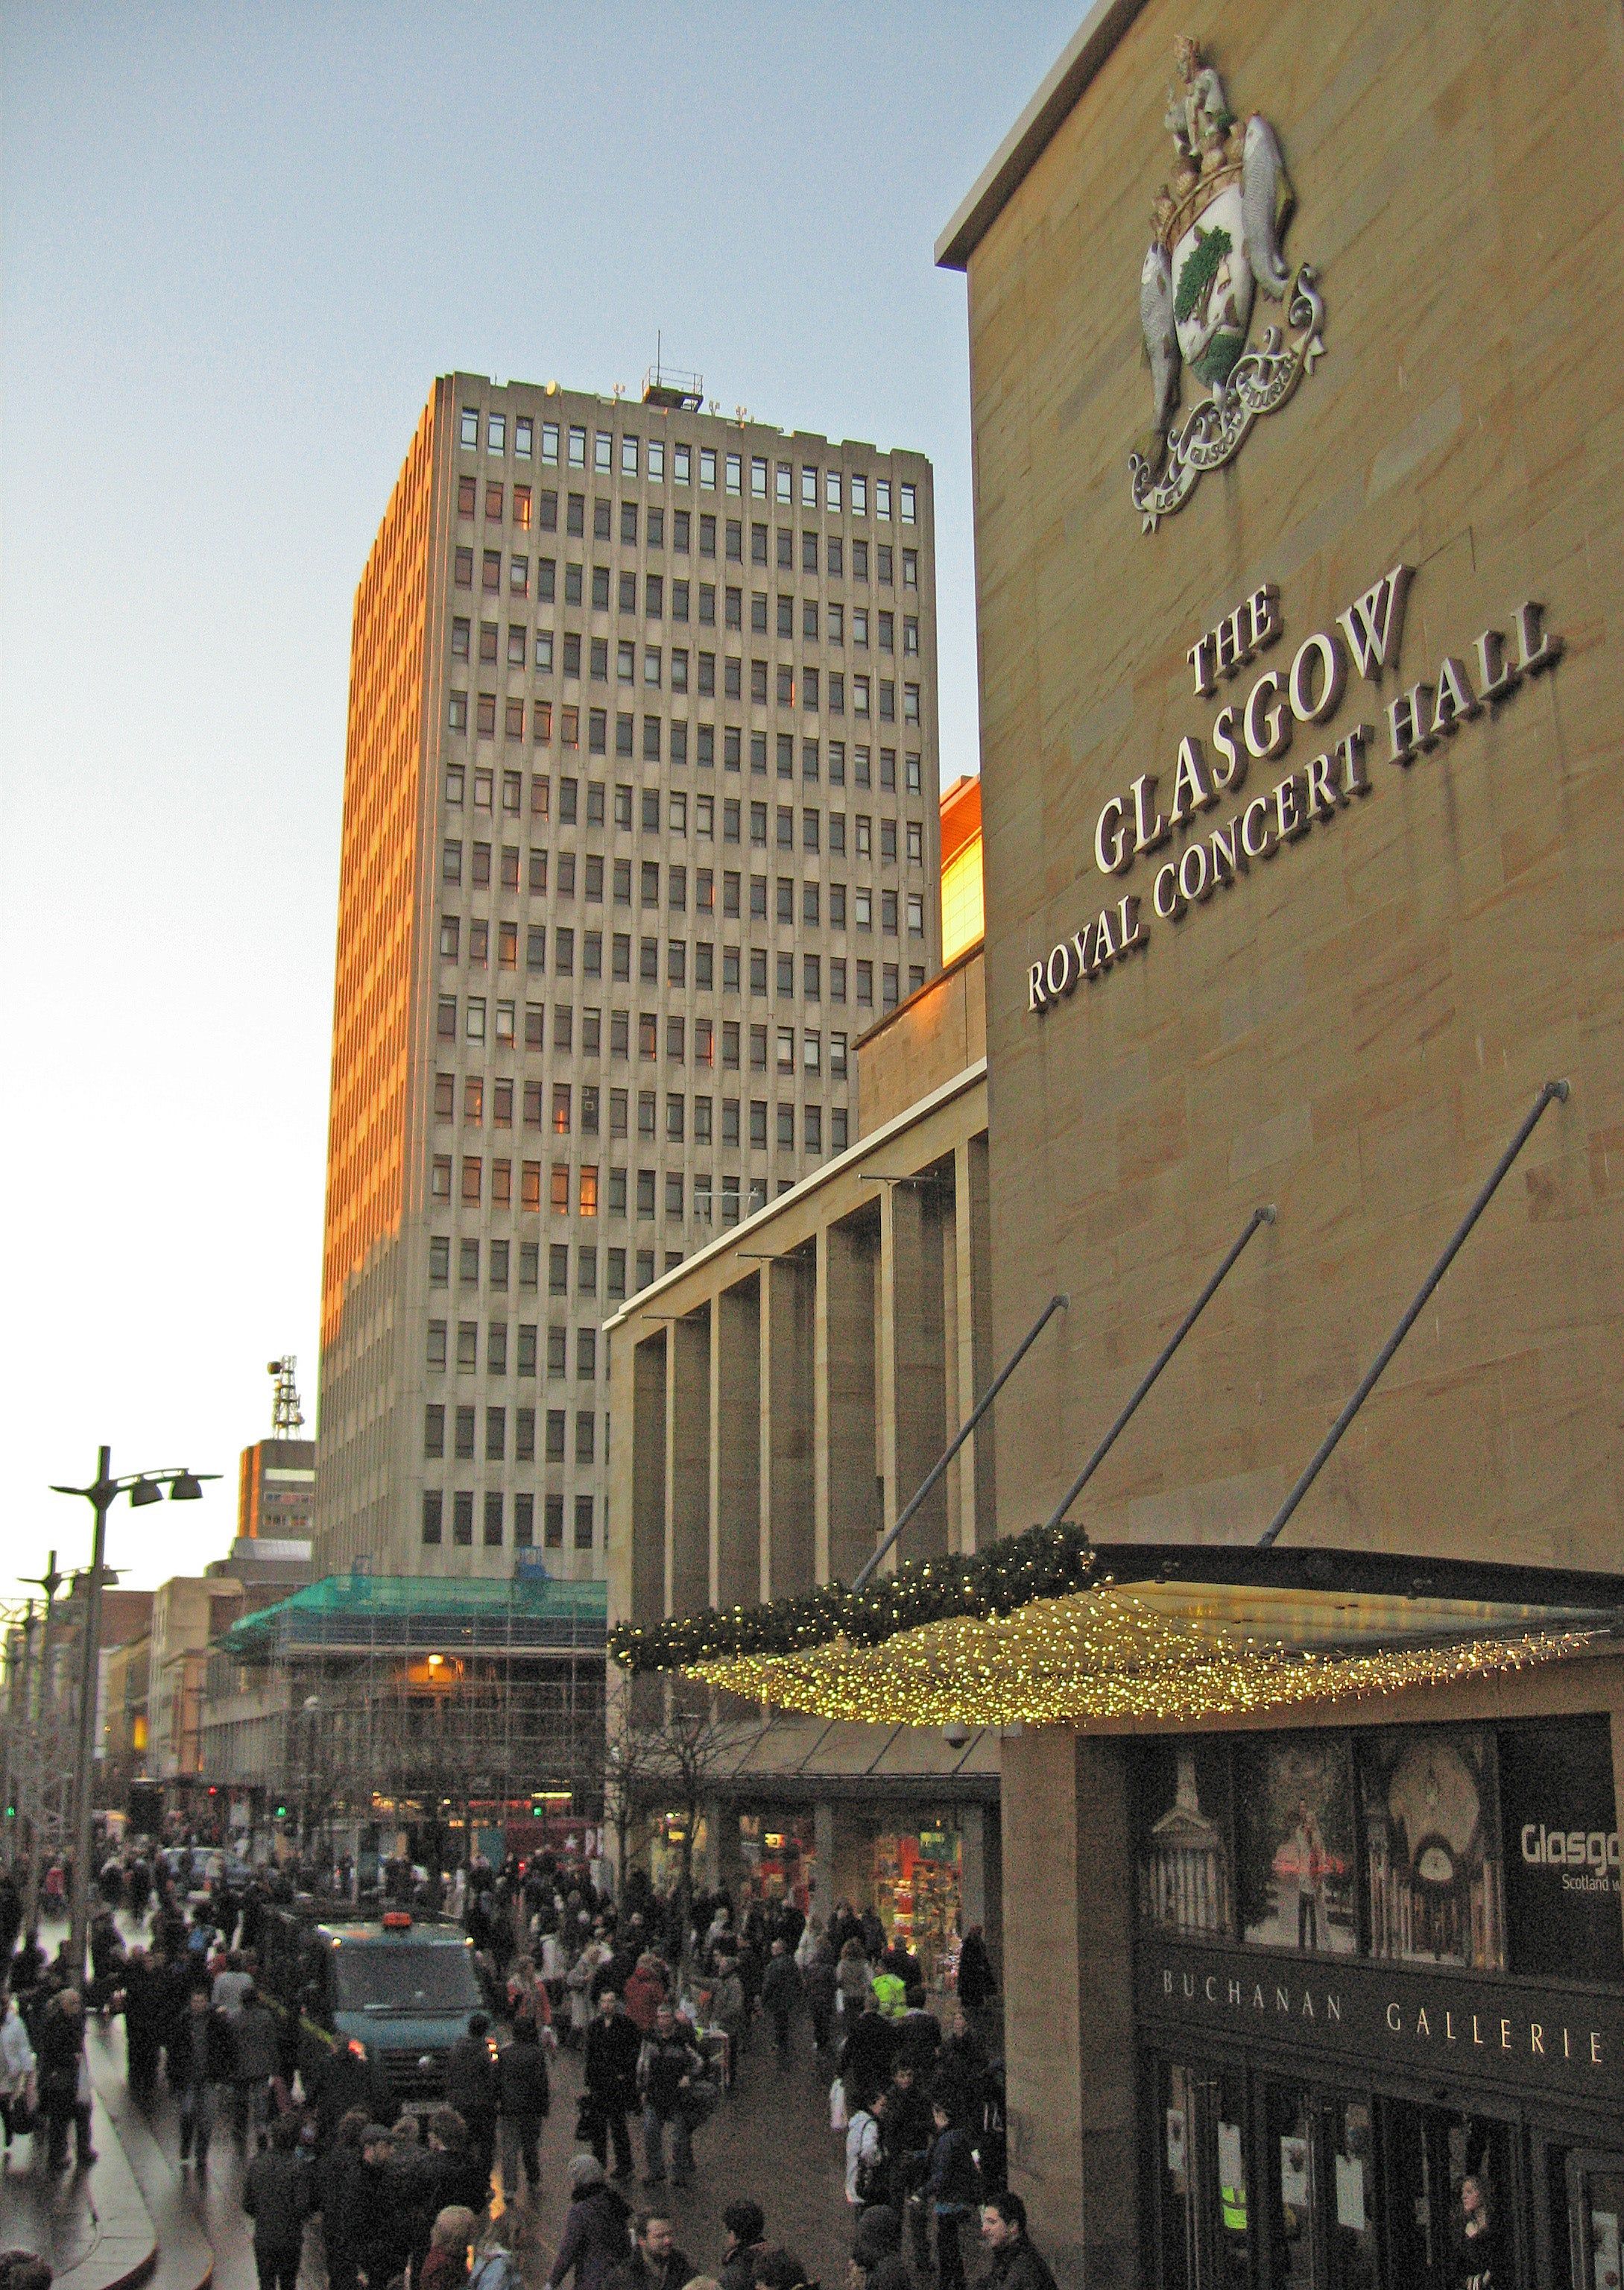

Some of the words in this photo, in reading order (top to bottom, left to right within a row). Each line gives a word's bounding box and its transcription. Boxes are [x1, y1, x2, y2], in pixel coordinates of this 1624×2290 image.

[1187, 584, 1274, 697] THE
[1094, 564, 1414, 874] GLASGOW
[1027, 895, 1144, 1012] ROYAL
[1152, 725, 1370, 918] CONCERT
[1383, 601, 1555, 765] HALL
[1562, 1873, 1609, 1890] Scotland
[1163, 1970, 1340, 2021] BUCHANAN
